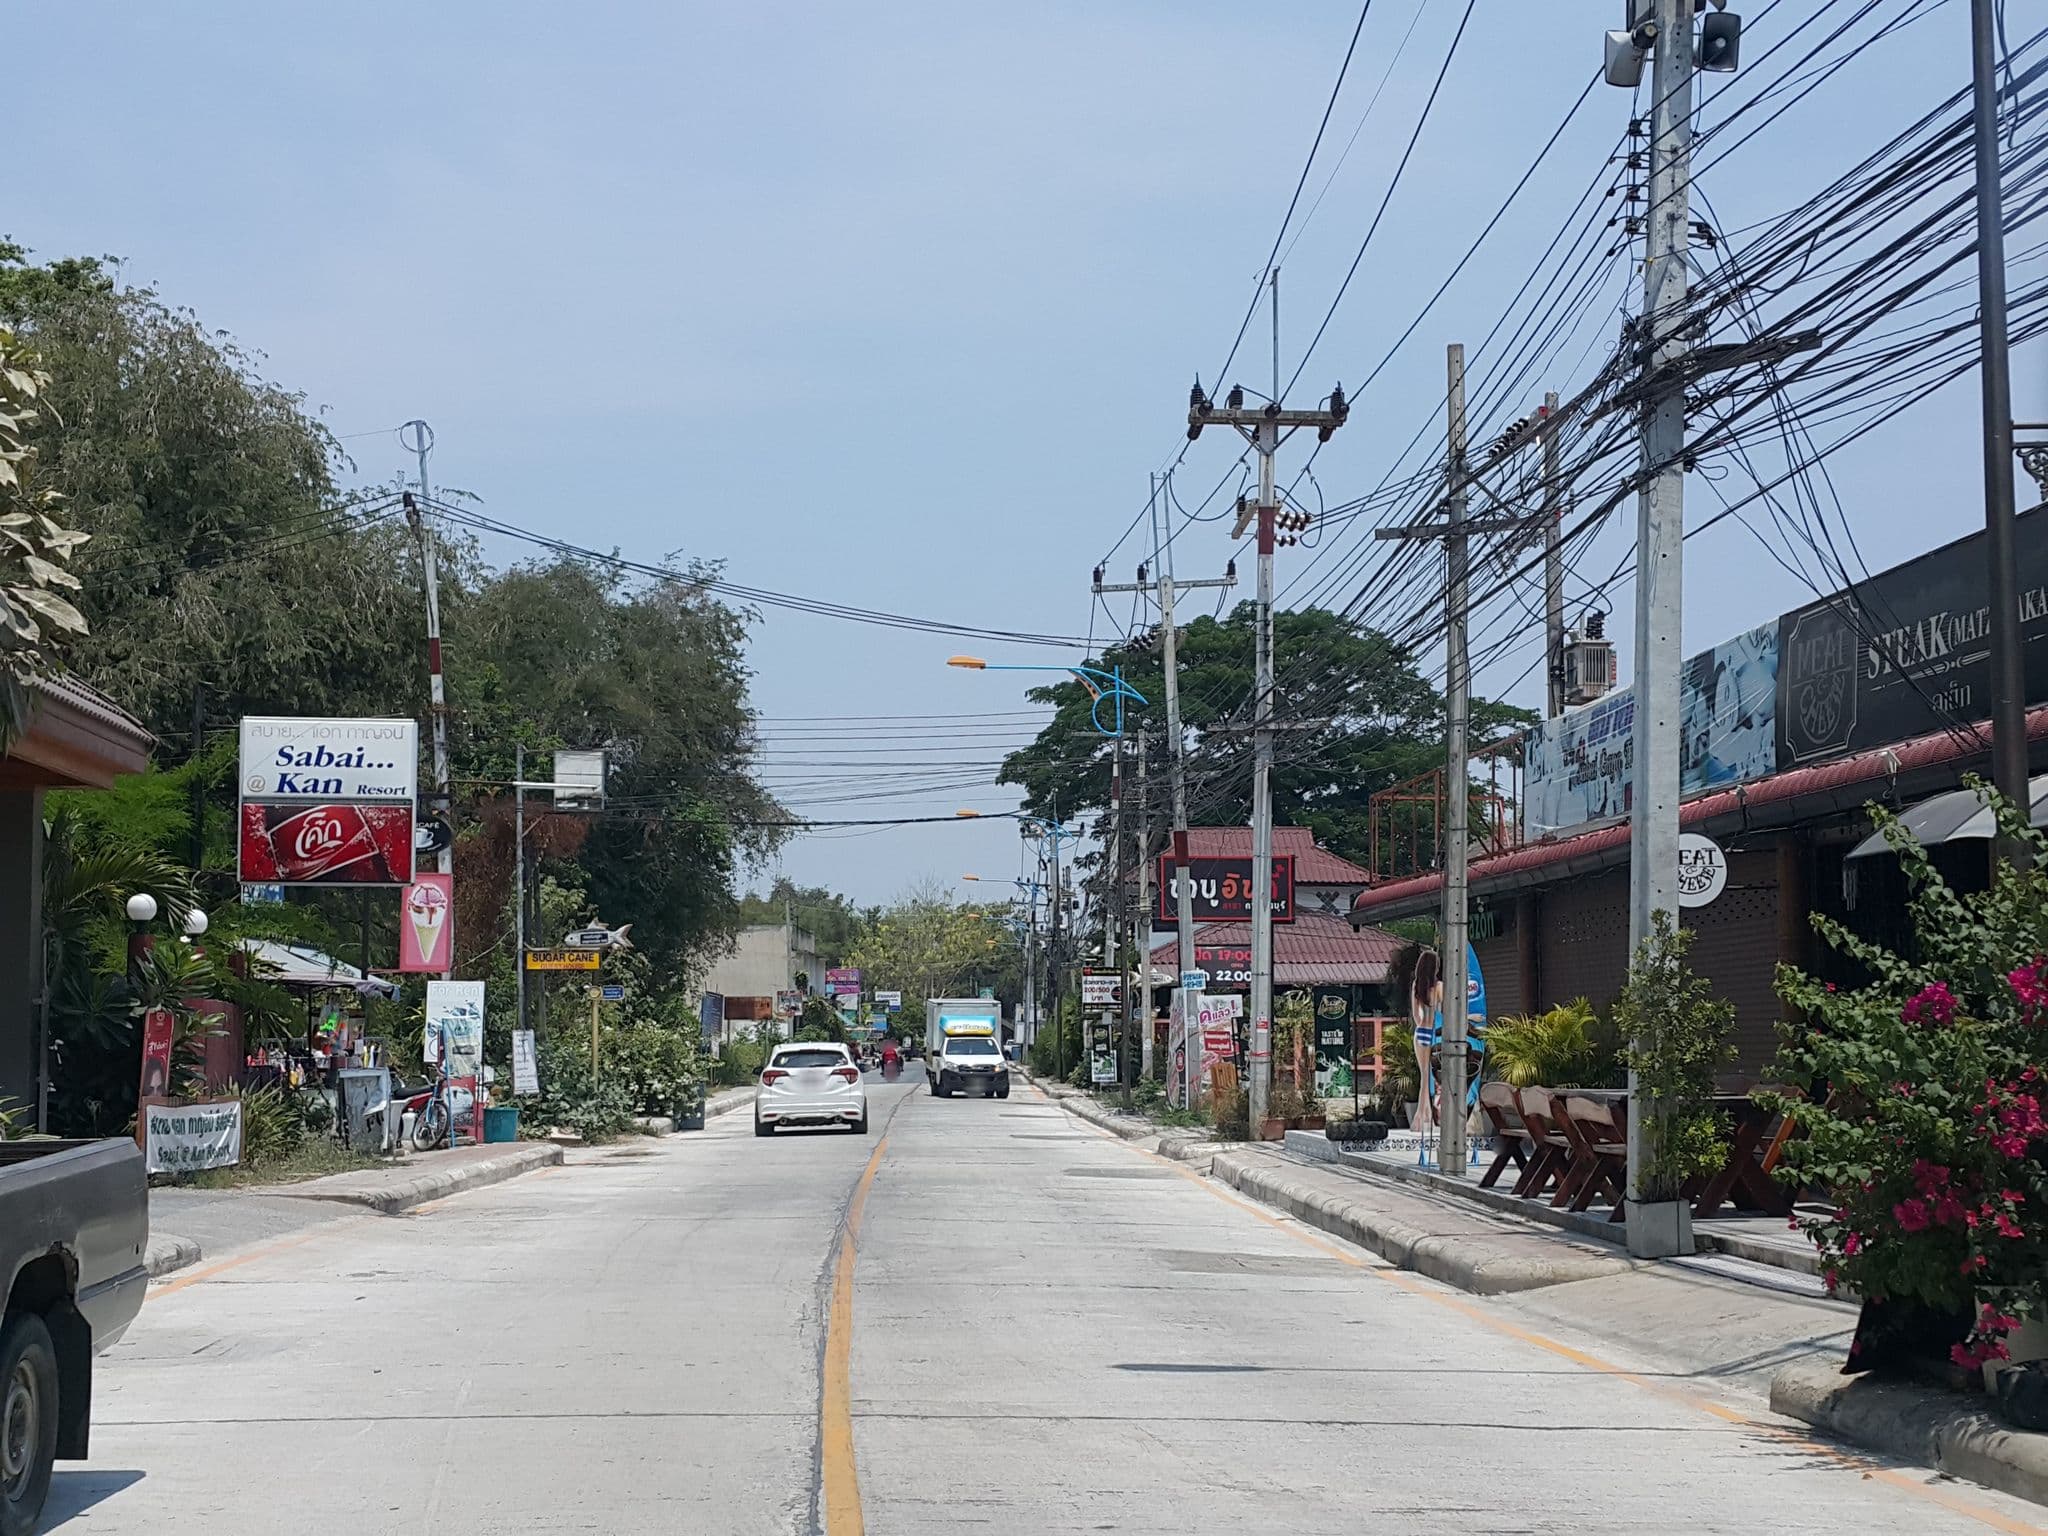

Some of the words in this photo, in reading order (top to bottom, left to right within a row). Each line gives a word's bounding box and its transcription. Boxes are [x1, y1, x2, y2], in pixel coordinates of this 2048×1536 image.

[1796, 628, 1847, 680] MEAT
[1867, 611, 1949, 680] STEAK
[275, 744, 394, 769] Sabai...
[247, 775, 266, 793] @
[274, 772, 343, 794] Kan
[356, 784, 407, 796] Resort
[1679, 847, 1717, 866] EAT
[532, 952, 566, 963] SUGAR
[567, 952, 595, 963] CANE
[431, 984, 449, 996] For
[454, 984, 482, 996] Rent
